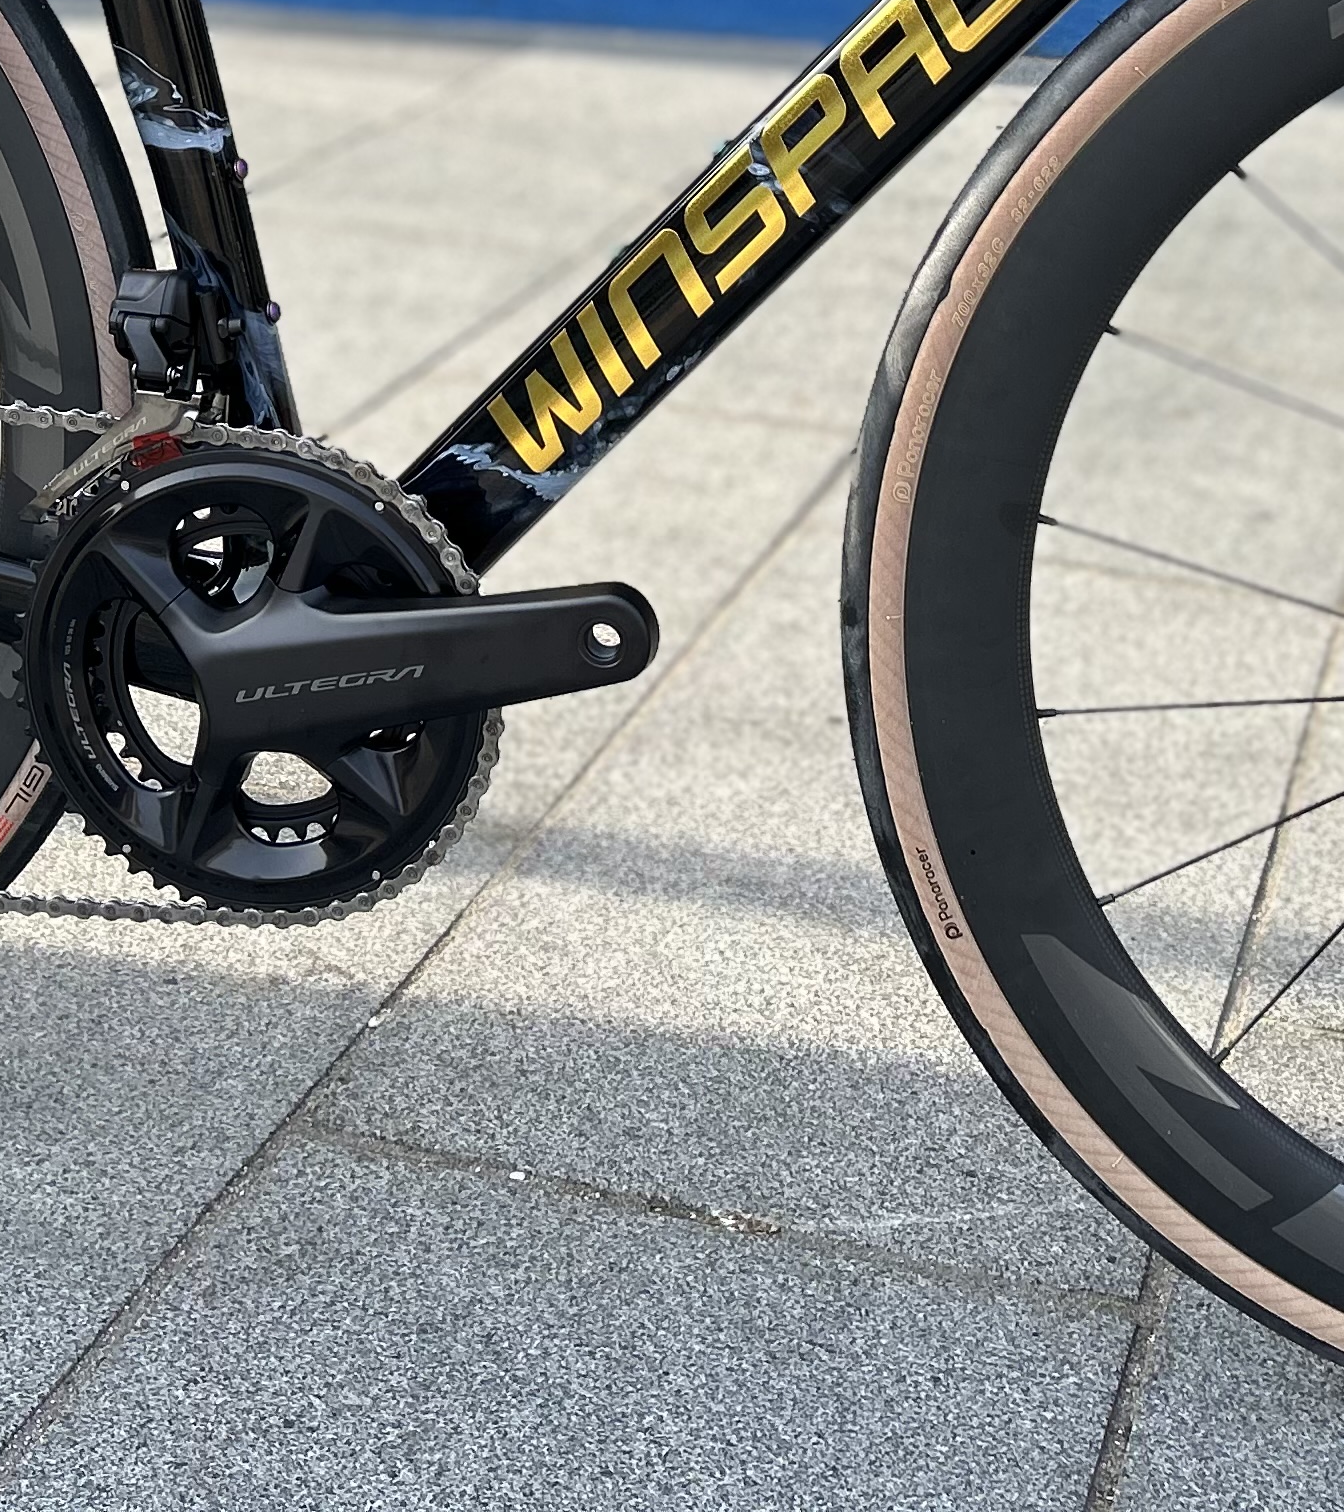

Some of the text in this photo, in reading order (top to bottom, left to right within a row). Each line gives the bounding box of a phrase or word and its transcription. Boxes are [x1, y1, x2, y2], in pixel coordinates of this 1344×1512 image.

[73, 416, 148, 477] ULTEGRA
[63, 661, 97, 760] ULTEGRA
[235, 664, 425, 704] ULTEGRA
[916, 847, 953, 922] Panaracer
